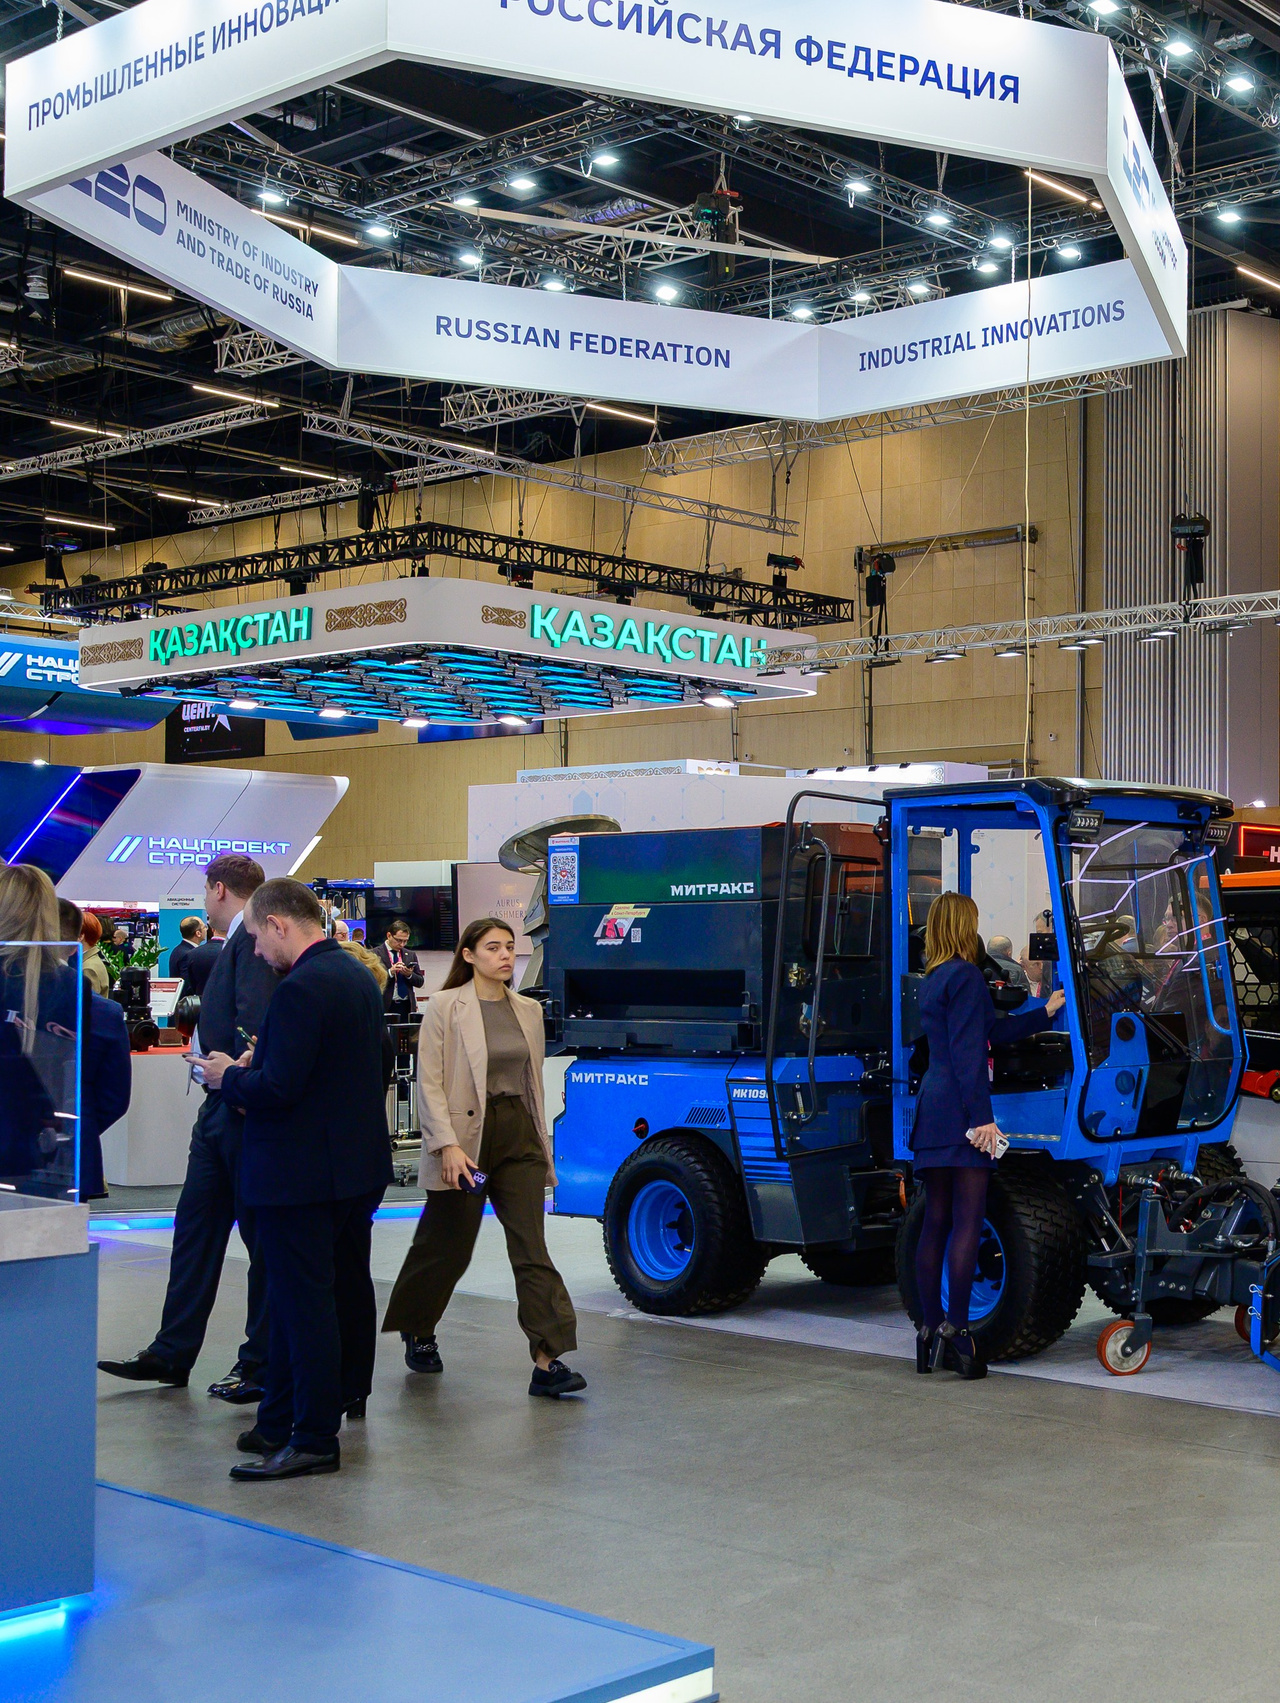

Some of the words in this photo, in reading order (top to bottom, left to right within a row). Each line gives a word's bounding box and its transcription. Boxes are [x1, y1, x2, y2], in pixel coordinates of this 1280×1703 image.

[28, 31, 205, 131] ПРОМЫШЛЕННЫЕ
[212, 0, 340, 54] ИННОВАЦ
[500, 0, 782, 59] ОССИЙСКАЯ
[795, 35, 1019, 104] ФЕДЕРАЦИЯ
[176, 199, 239, 251] MINISTRY
[242, 240, 259, 261] OF
[261, 250, 319, 298] INDUSTRY
[176, 228, 206, 259] AND
[209, 246, 251, 285] TRADE
[253, 273, 270, 295] OF
[272, 283, 314, 321] RUSSIA
[435, 315, 560, 349] RUSSIAN
[569, 331, 731, 369] FEDERATION
[858, 330, 976, 372] INDUSTRIAL
[981, 299, 1126, 348] INNOVATIONS
[149, 606, 313, 666] ҚАЗАҚСТАН
[530, 603, 767, 669] ҚАЗАҚСТАН
[148, 837, 291, 854] НАЦПРОЕКТ
[488, 910, 527, 919] CASHMER
[495, 899, 520, 908] AURUS
[670, 882, 754, 896] МИТРАКС
[571, 1072, 649, 1086] МИТРАКС
